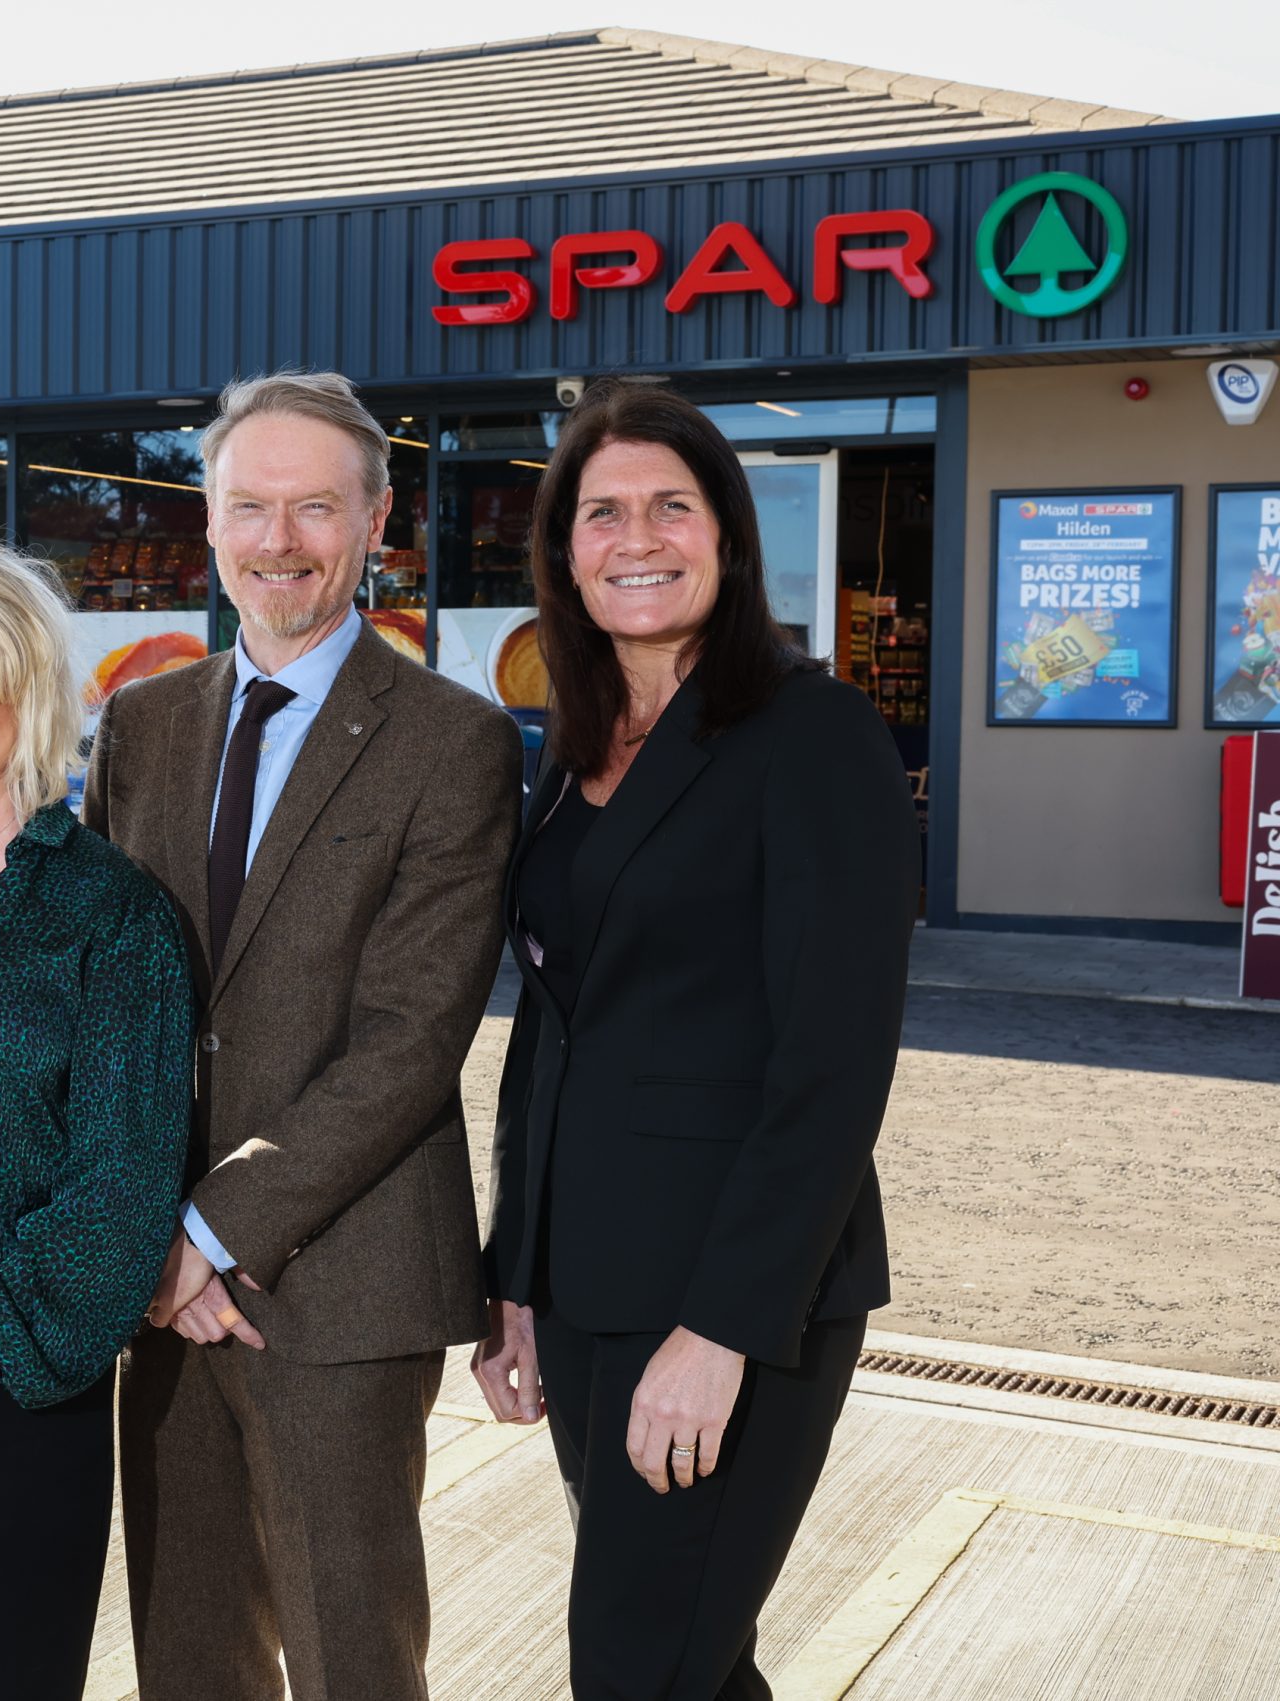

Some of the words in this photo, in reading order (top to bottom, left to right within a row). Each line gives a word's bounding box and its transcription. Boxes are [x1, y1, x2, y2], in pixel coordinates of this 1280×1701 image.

[432, 208, 937, 327] SPAR
[1038, 503, 1078, 516] Maxol
[1096, 504, 1137, 514] SPAR
[1057, 521, 1111, 536] Hilden
[1021, 564, 1077, 581] BAGS
[1082, 565, 1141, 581] MORE
[1020, 583, 1140, 608] PRIZES!
[1251, 799, 1280, 936] Delish
